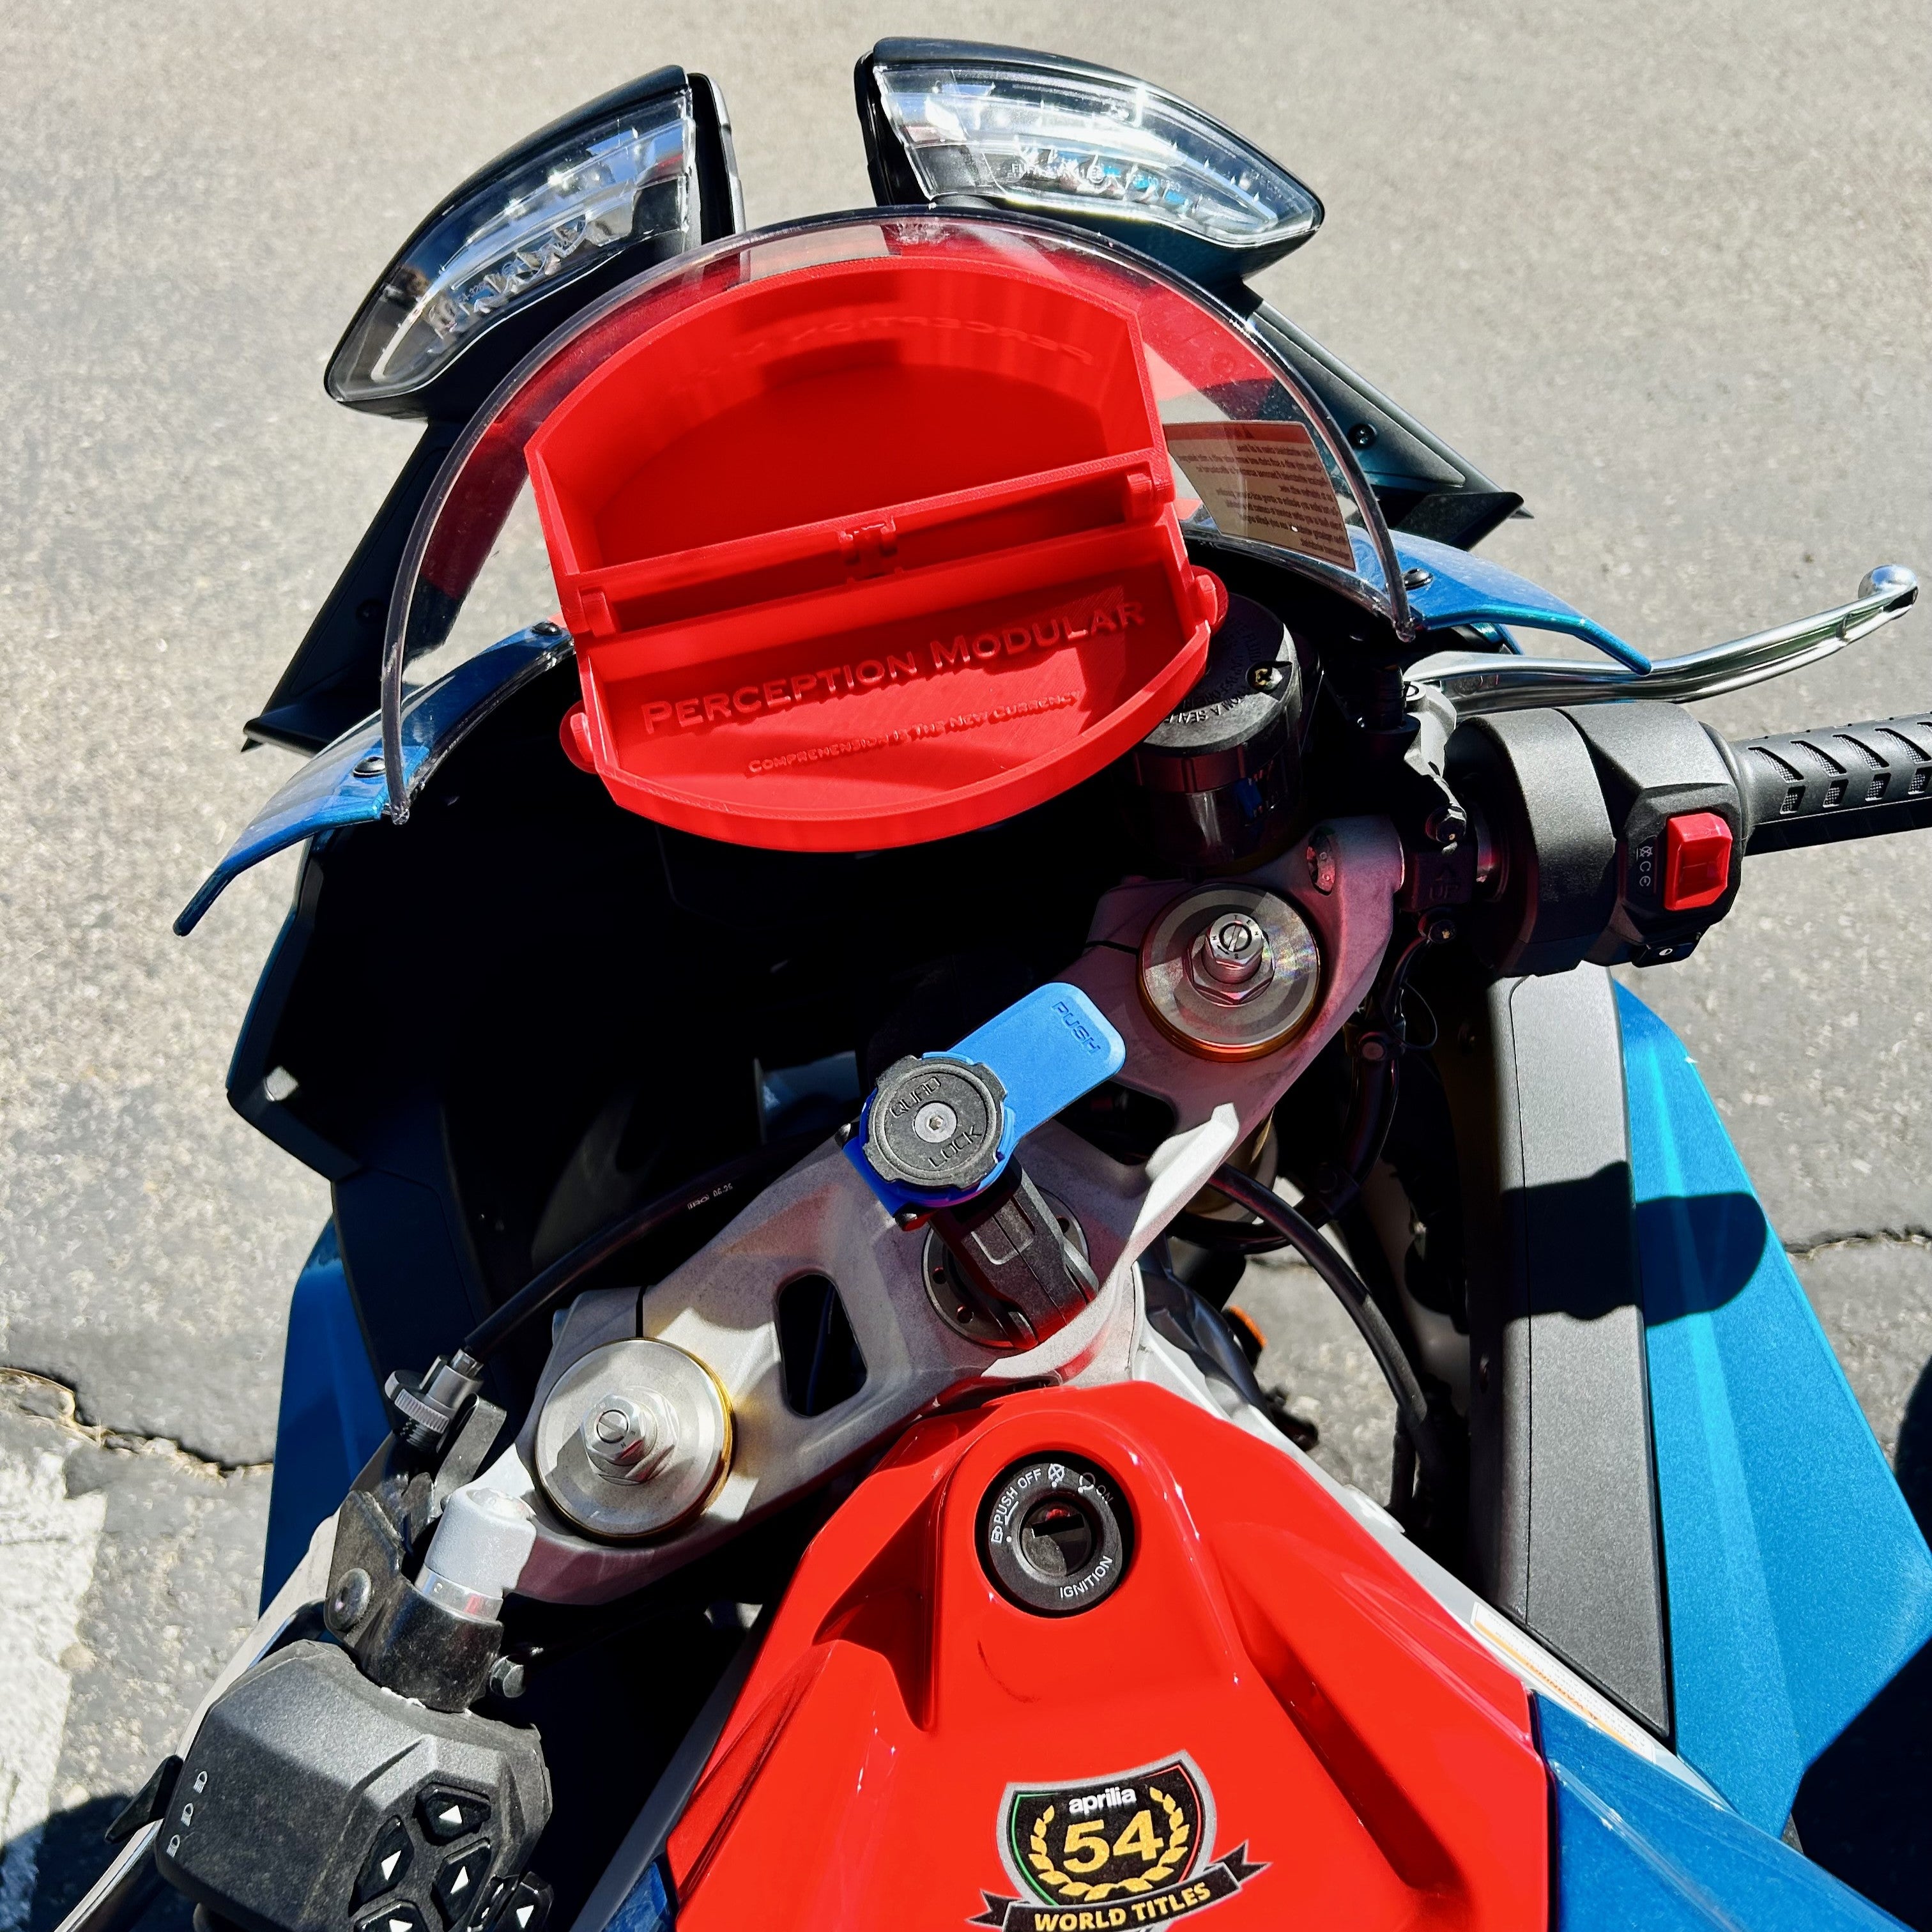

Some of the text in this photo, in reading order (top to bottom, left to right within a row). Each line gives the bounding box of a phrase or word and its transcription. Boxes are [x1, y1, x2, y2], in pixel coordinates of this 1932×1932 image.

[641, 601, 1146, 734] PERCEPTION MODULAR
[748, 734, 889, 772] COMPREHENSION
[912, 720, 946, 736] THE
[949, 710, 989, 728] NEW
[992, 690, 1081, 719] CURRENCY
[1050, 1000, 1101, 1056] PUSH
[889, 1077, 942, 1119] QUAD
[928, 1125, 983, 1168] LOCK
[993, 1468, 1042, 1524] PUSH OFF
[1096, 1484, 1114, 1505] ON
[1060, 1555, 1114, 1598] IGNITION
[1068, 1786, 1137, 1814] aprilia
[1063, 1809, 1164, 1873] 54
[1034, 1882, 1211, 1932] WORLD TITLES
